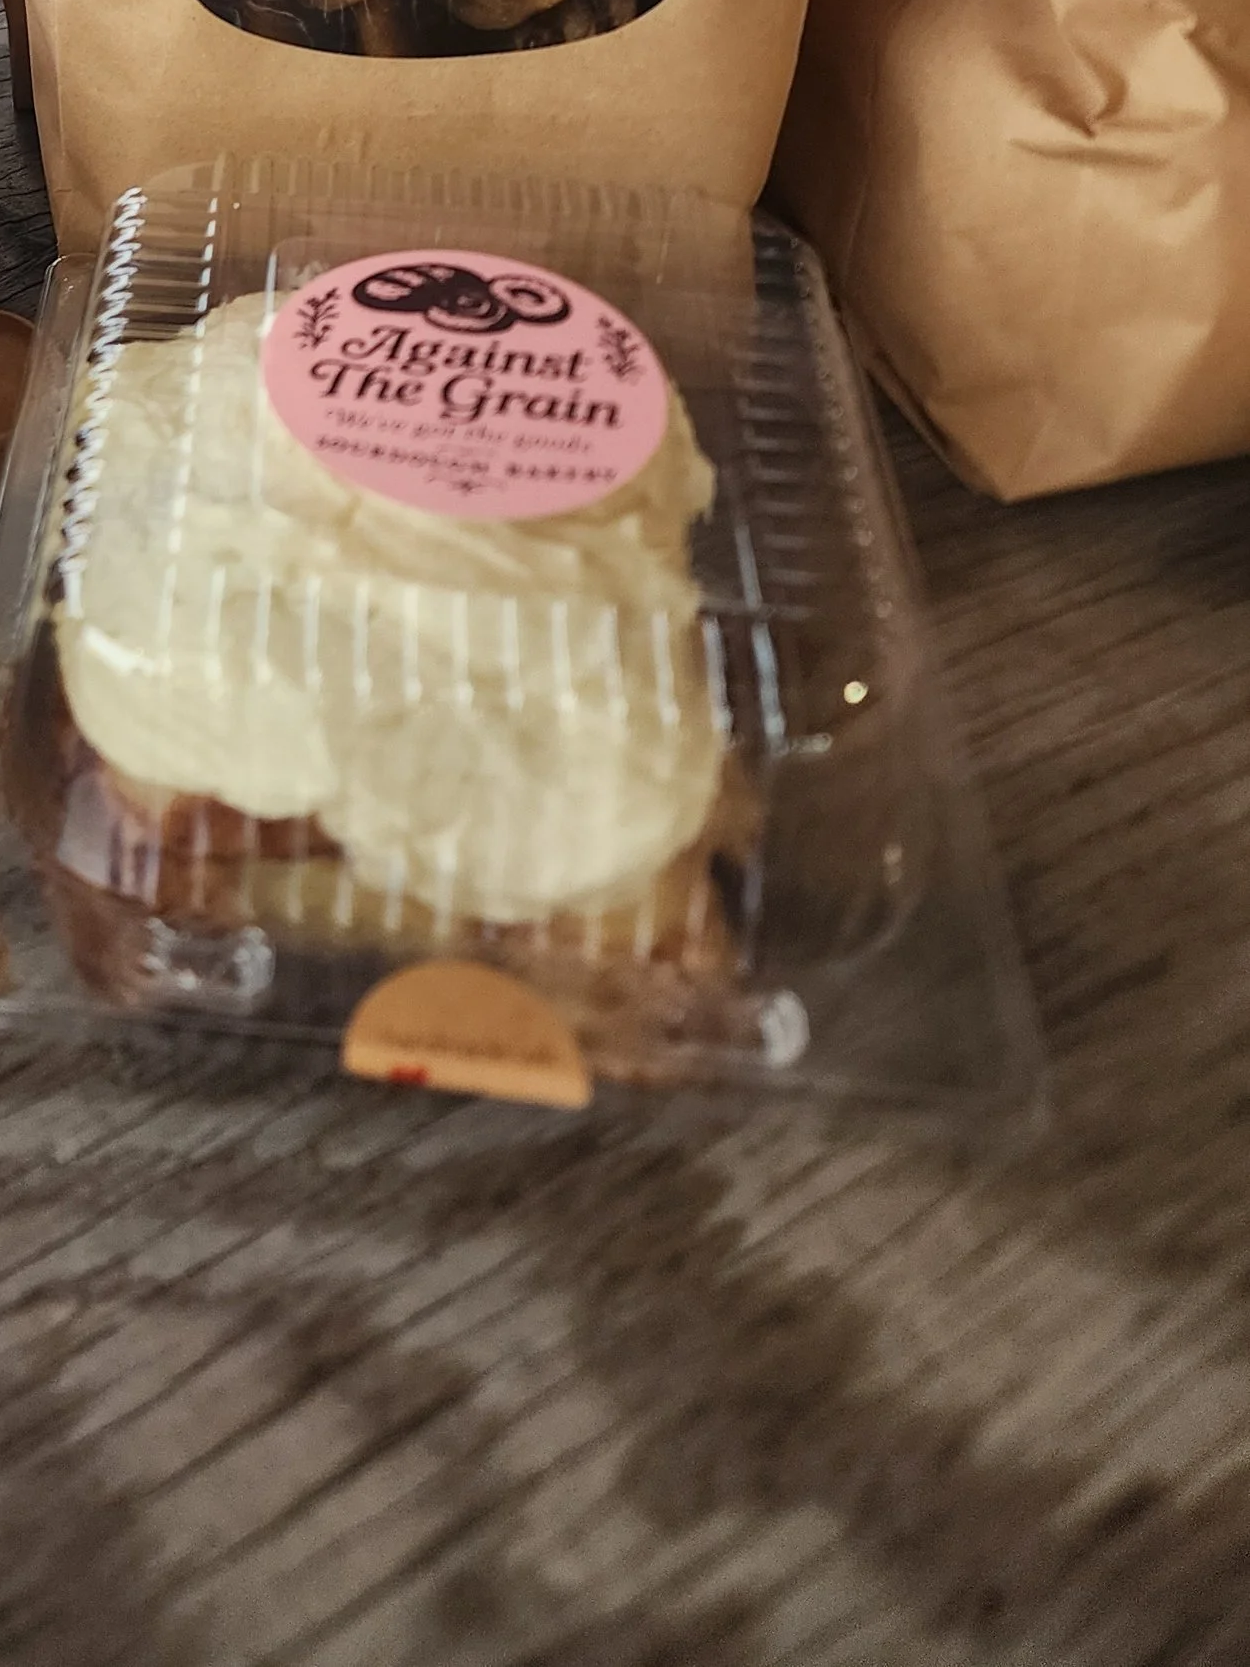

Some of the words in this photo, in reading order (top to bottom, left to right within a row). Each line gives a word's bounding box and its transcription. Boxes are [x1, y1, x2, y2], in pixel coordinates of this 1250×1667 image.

[340, 323, 591, 382] Against
[310, 358, 424, 407] The
[439, 373, 623, 430] Grain
